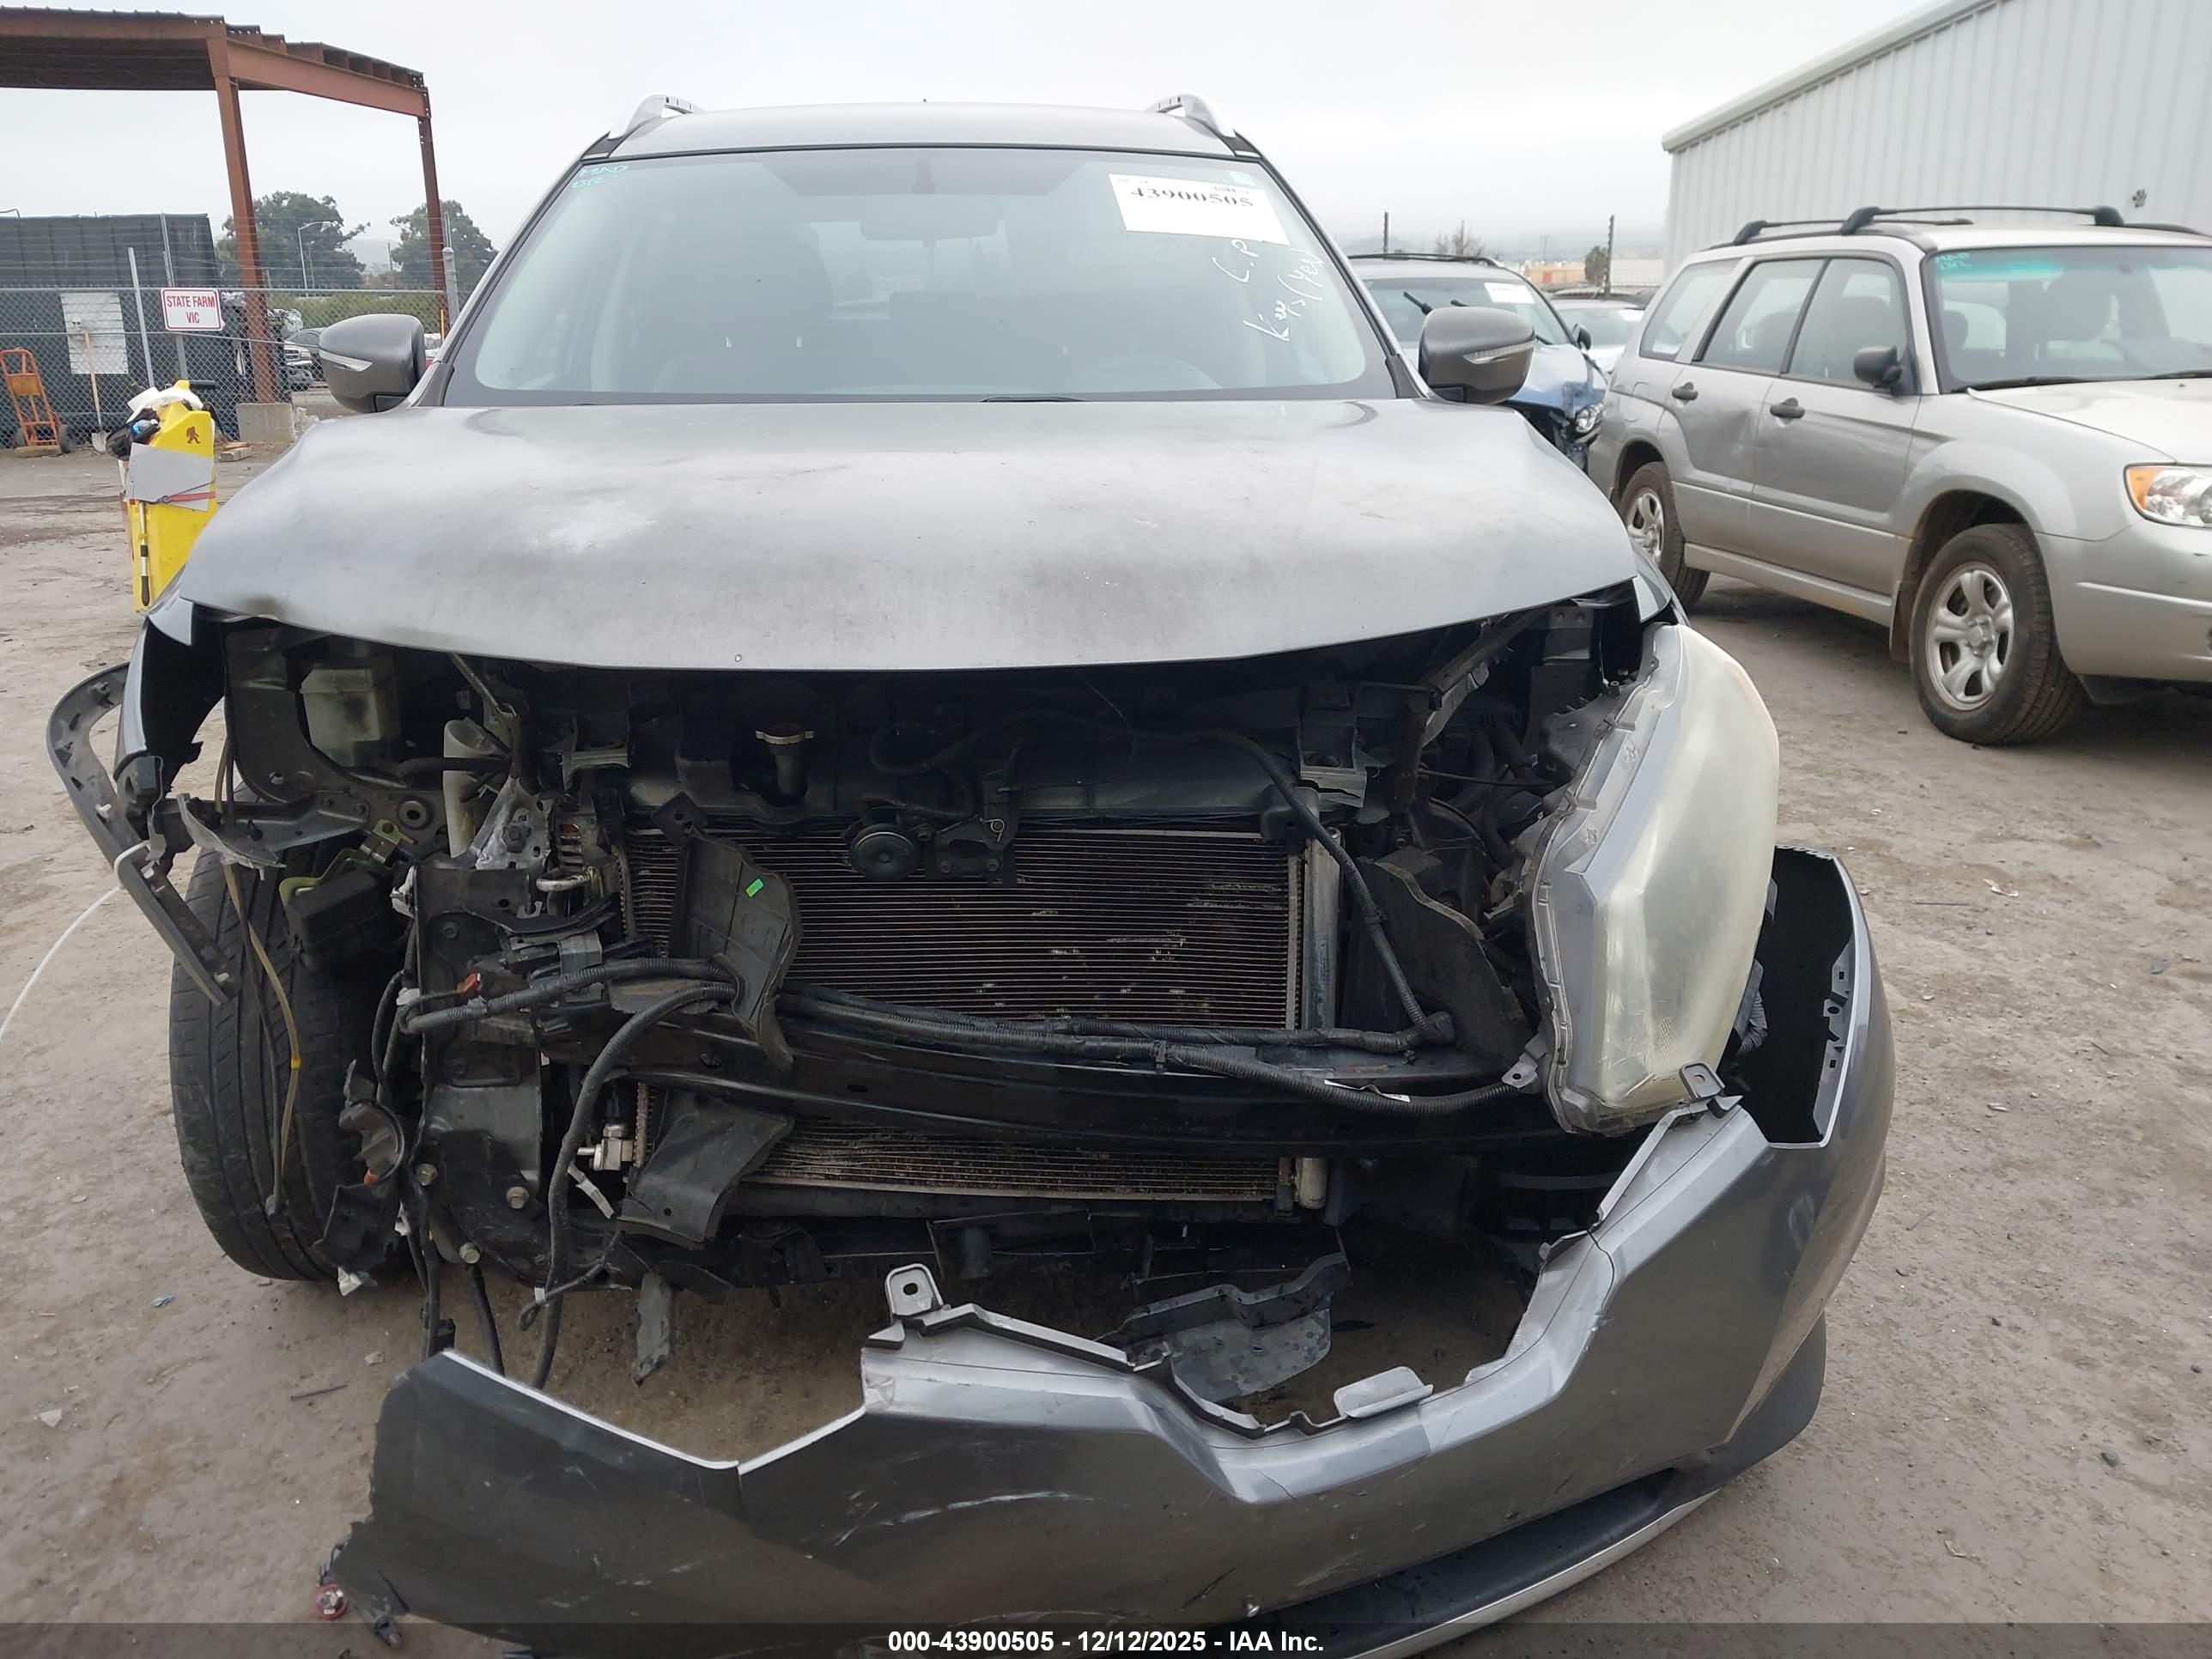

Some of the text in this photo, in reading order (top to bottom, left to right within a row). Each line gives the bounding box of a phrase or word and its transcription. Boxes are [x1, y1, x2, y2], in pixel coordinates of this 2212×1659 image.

[1129, 186, 1254, 207] 43900505
[167, 295, 216, 307] STATE FARM
[185, 311, 200, 324] VIC
